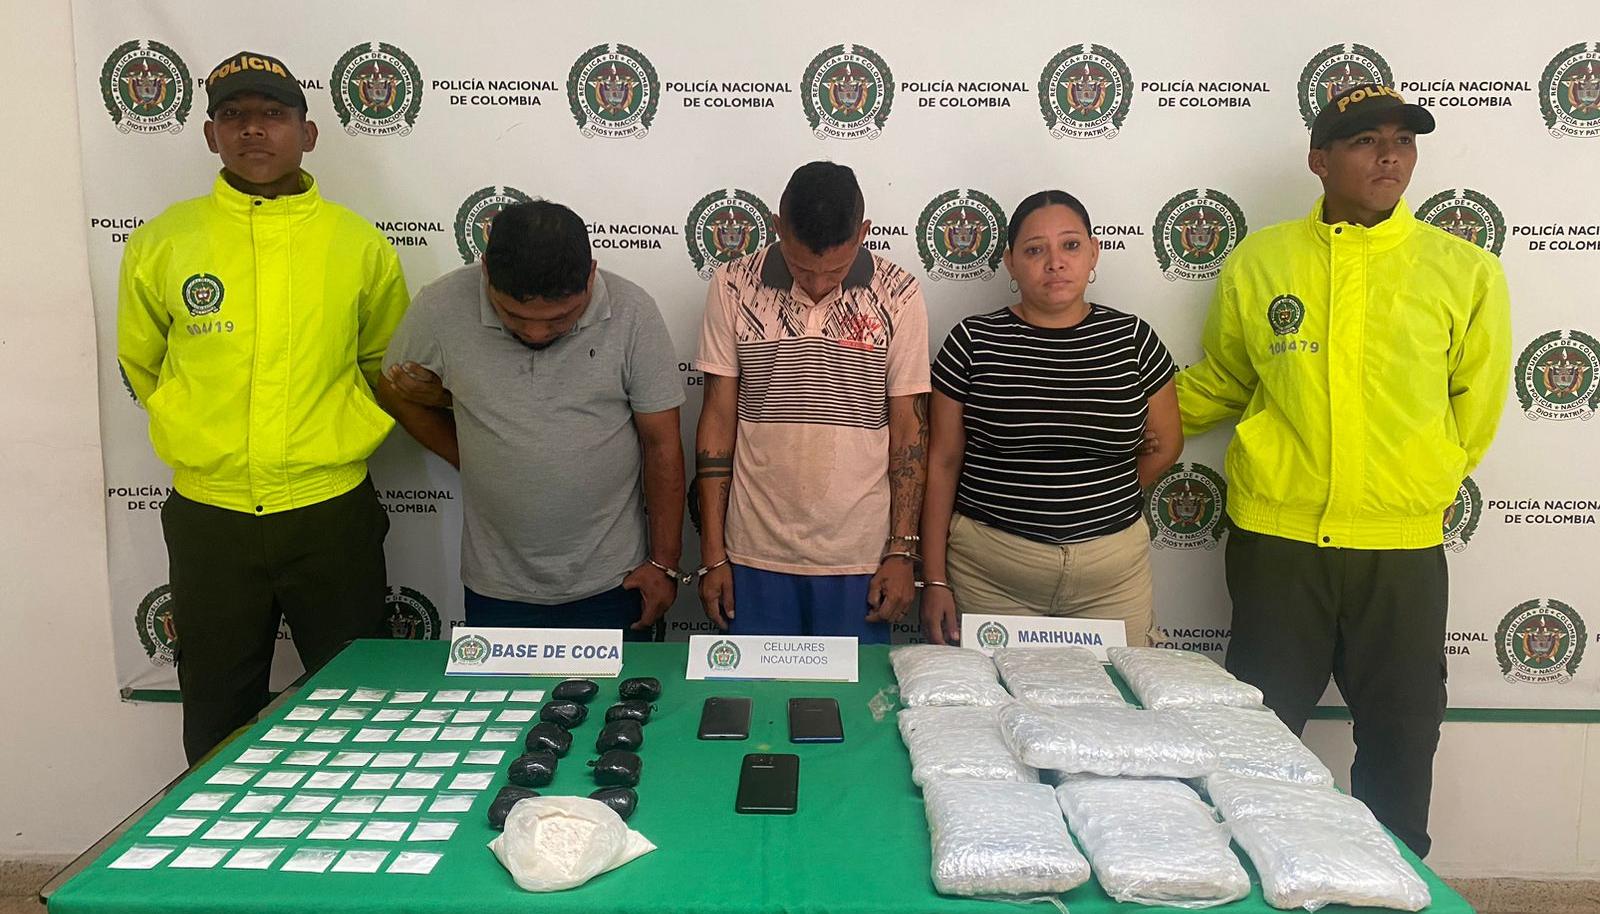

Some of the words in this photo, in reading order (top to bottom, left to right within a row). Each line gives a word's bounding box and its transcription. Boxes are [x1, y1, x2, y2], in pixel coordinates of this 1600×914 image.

[113, 54, 133, 92] REPUBLICA
[158, 55, 182, 93] COLOMBIA
[342, 57, 364, 94] REPUBLICA
[389, 58, 411, 95] COLOMBIA
[579, 58, 602, 96] REPUBLICA
[626, 59, 648, 97] COLOMBIA
[813, 59, 837, 97] REPUBLICA
[861, 59, 883, 97] COLOMBIA
[1050, 59, 1076, 97] REPUBLICA
[1100, 59, 1121, 97] COLOMBIA
[1310, 58, 1336, 97] REPUBLICA
[1361, 59, 1381, 84] COLOM
[1551, 57, 1578, 96] REPUBLICA
[432, 78, 485, 90] POLICÍA
[488, 80, 558, 91] NACIONAL
[666, 80, 718, 92] POLICÍA
[722, 82, 792, 92] NACIONAL
[901, 80, 954, 92] POLICÍA
[958, 82, 1029, 92] NACIONAL
[1141, 80, 1194, 92] POLICÍA
[1198, 82, 1270, 92] NACIONAL
[1401, 79, 1455, 92] POLICÍA
[1459, 81, 1531, 91] NACIONAL
[450, 96, 467, 105] DE
[471, 96, 541, 106] COLOMBIA
[683, 98, 700, 107] DE
[704, 98, 774, 107] COLOMBIA
[919, 98, 936, 107] DE
[939, 98, 1011, 107] COLOMBIA
[1158, 98, 1176, 107] DE
[1179, 98, 1251, 107] COLOMBIA
[1337, 85, 1407, 113] POLIC
[1418, 97, 1436, 107] DE
[1439, 97, 1512, 107] COLOMBIA
[118, 101, 140, 121] POLICIA
[148, 101, 180, 123] NACIONAL
[347, 103, 370, 124] POLICIA
[378, 103, 409, 125] NACIONAL
[583, 105, 606, 126] POLICIA
[614, 105, 645, 127] NACIONAL
[817, 106, 839, 127] POLICIA
[848, 106, 879, 128] NACIONAL
[1054, 105, 1076, 127] POLICIA
[1085, 106, 1117, 128] NACIONAL
[1554, 105, 1577, 126] POLICIA
[149, 121, 173, 132] PATRIA
[378, 124, 402, 134] PATRIA
[614, 126, 638, 136] PATRIA
[1084, 126, 1108, 137] PATRIA
[847, 127, 871, 138] PATRIA
[376, 221, 445, 232] NACIONAL
[928, 203, 953, 240] REPUBLICA
[976, 204, 997, 240] COLOMBIA
[1165, 203, 1191, 240] REPUBLICA
[1215, 204, 1235, 240] COLOMBIA
[1472, 204, 1494, 241] COLOMBIA
[610, 224, 678, 235] NACIONAL
[868, 226, 908, 235] IONAL
[1093, 226, 1144, 235] CIONAL
[1512, 223, 1564, 235] POLICÍA
[1568, 226, 1600, 235] NACI
[387, 236, 427, 246] OMBIA
[592, 239, 661, 249] COLOMBIA
[1529, 241, 1546, 250] DE
[1549, 241, 1600, 250] COLOM
[931, 249, 954, 269] POLICIA
[961, 249, 993, 270] NACIONAL
[1168, 249, 1190, 269] POLICIA
[1199, 249, 1231, 269] NACIONAL
[961, 268, 985, 279] PATRIA
[1198, 268, 1221, 279] PATRIA
[1527, 343, 1553, 380] REPUBLICA
[1579, 344, 1600, 380] COLOMBIA
[688, 377, 703, 385] DE
[1530, 389, 1552, 409] POLICIA
[1561, 389, 1596, 410] NACIONAL
[1560, 408, 1585, 418] PATRIA
[108, 485, 162, 497] POLICÍA
[386, 490, 454, 500] NACIONAL
[128, 501, 146, 510] DE
[380, 504, 437, 513] OLOMBIA
[1488, 499, 1541, 510] POLICÍA
[1544, 501, 1600, 510] NACIONA
[1504, 515, 1521, 524] DE
[1525, 515, 1595, 524] COLOMBIA
[893, 623, 920, 632] POLI
[1173, 628, 1232, 638] NACIONA
[1507, 612, 1532, 646] REPUBLICA
[1556, 613, 1575, 646] COLOMBIA
[1018, 630, 1103, 646] MARIHUANA
[1448, 632, 1488, 641] IONAL
[491, 643, 538, 658] BASE
[543, 645, 566, 658] DE
[571, 645, 619, 659] COCA
[764, 642, 825, 652] CELULARES
[760, 655, 828, 665] INCAUTADOS
[1510, 654, 1531, 672] POLICIA
[1540, 654, 1570, 673] NACIONAL
[1537, 673, 1562, 681] PATRIA
